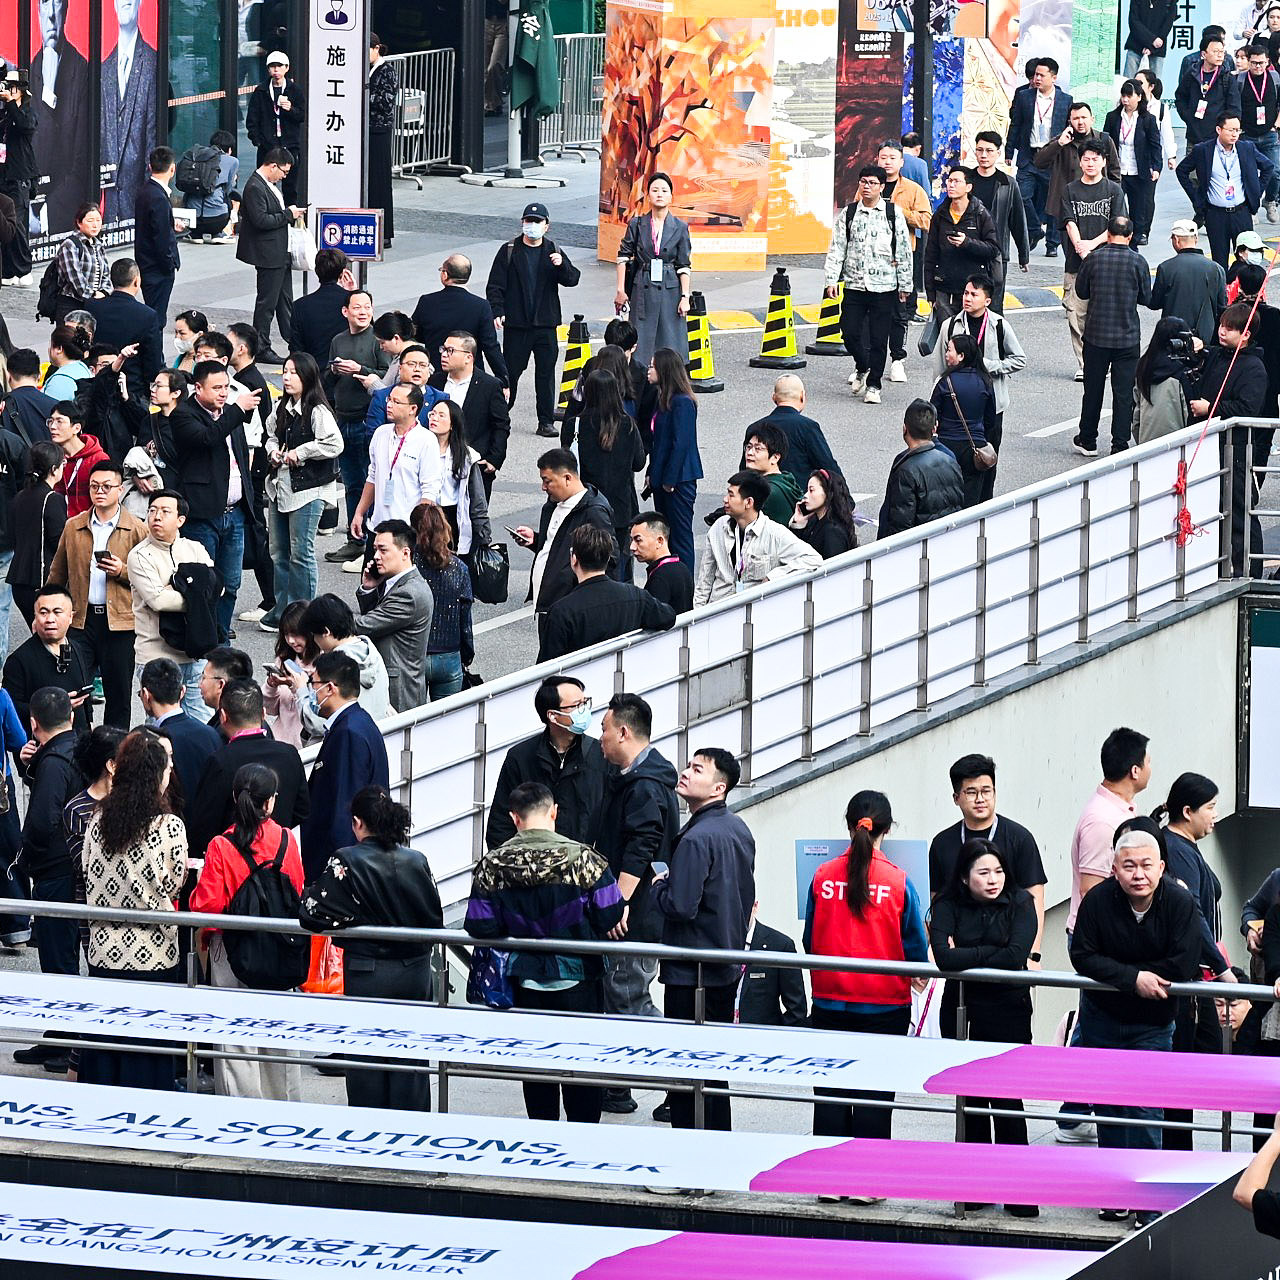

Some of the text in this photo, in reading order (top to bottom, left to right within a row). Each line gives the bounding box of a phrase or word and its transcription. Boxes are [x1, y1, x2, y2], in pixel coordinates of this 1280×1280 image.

[325, 44, 346, 166] 施工办证
[342, 234, 374, 246] 禁止停车
[343, 224, 375, 236] 消防通道
[821, 880, 891, 904] STFF
[330, 1037, 380, 1048] ALL
[387, 1041, 415, 1050] IN
[417, 1044, 600, 1066] GUANGZHOU
[601, 1058, 742, 1072] DESIGN
[747, 1065, 833, 1078] WEEK
[96, 1110, 201, 1131] ALL
[218, 1120, 568, 1160] SOLUTIONS,
[261, 1138, 488, 1163] DESIGN
[501, 1156, 670, 1175] WEEK
[20, 1234, 237, 1262] GUANGZHOU
[242, 1251, 370, 1269] DESIGN
[375, 1260, 471, 1275] WEEK
